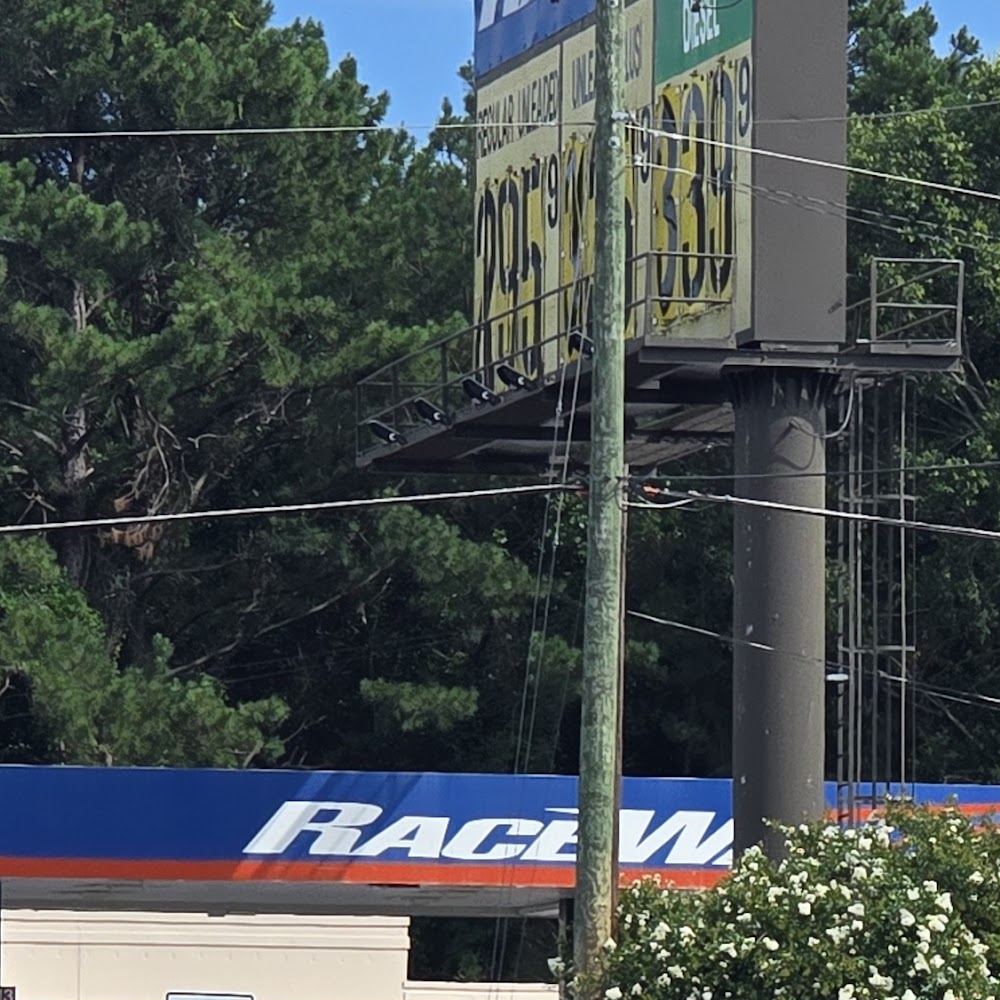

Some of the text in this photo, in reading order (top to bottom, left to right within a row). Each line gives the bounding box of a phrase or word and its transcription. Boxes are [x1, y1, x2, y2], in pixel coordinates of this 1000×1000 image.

[682, 0, 720, 53] DIESEL
[573, 50, 597, 109] UNLE
[242, 801, 734, 864] RACEW
